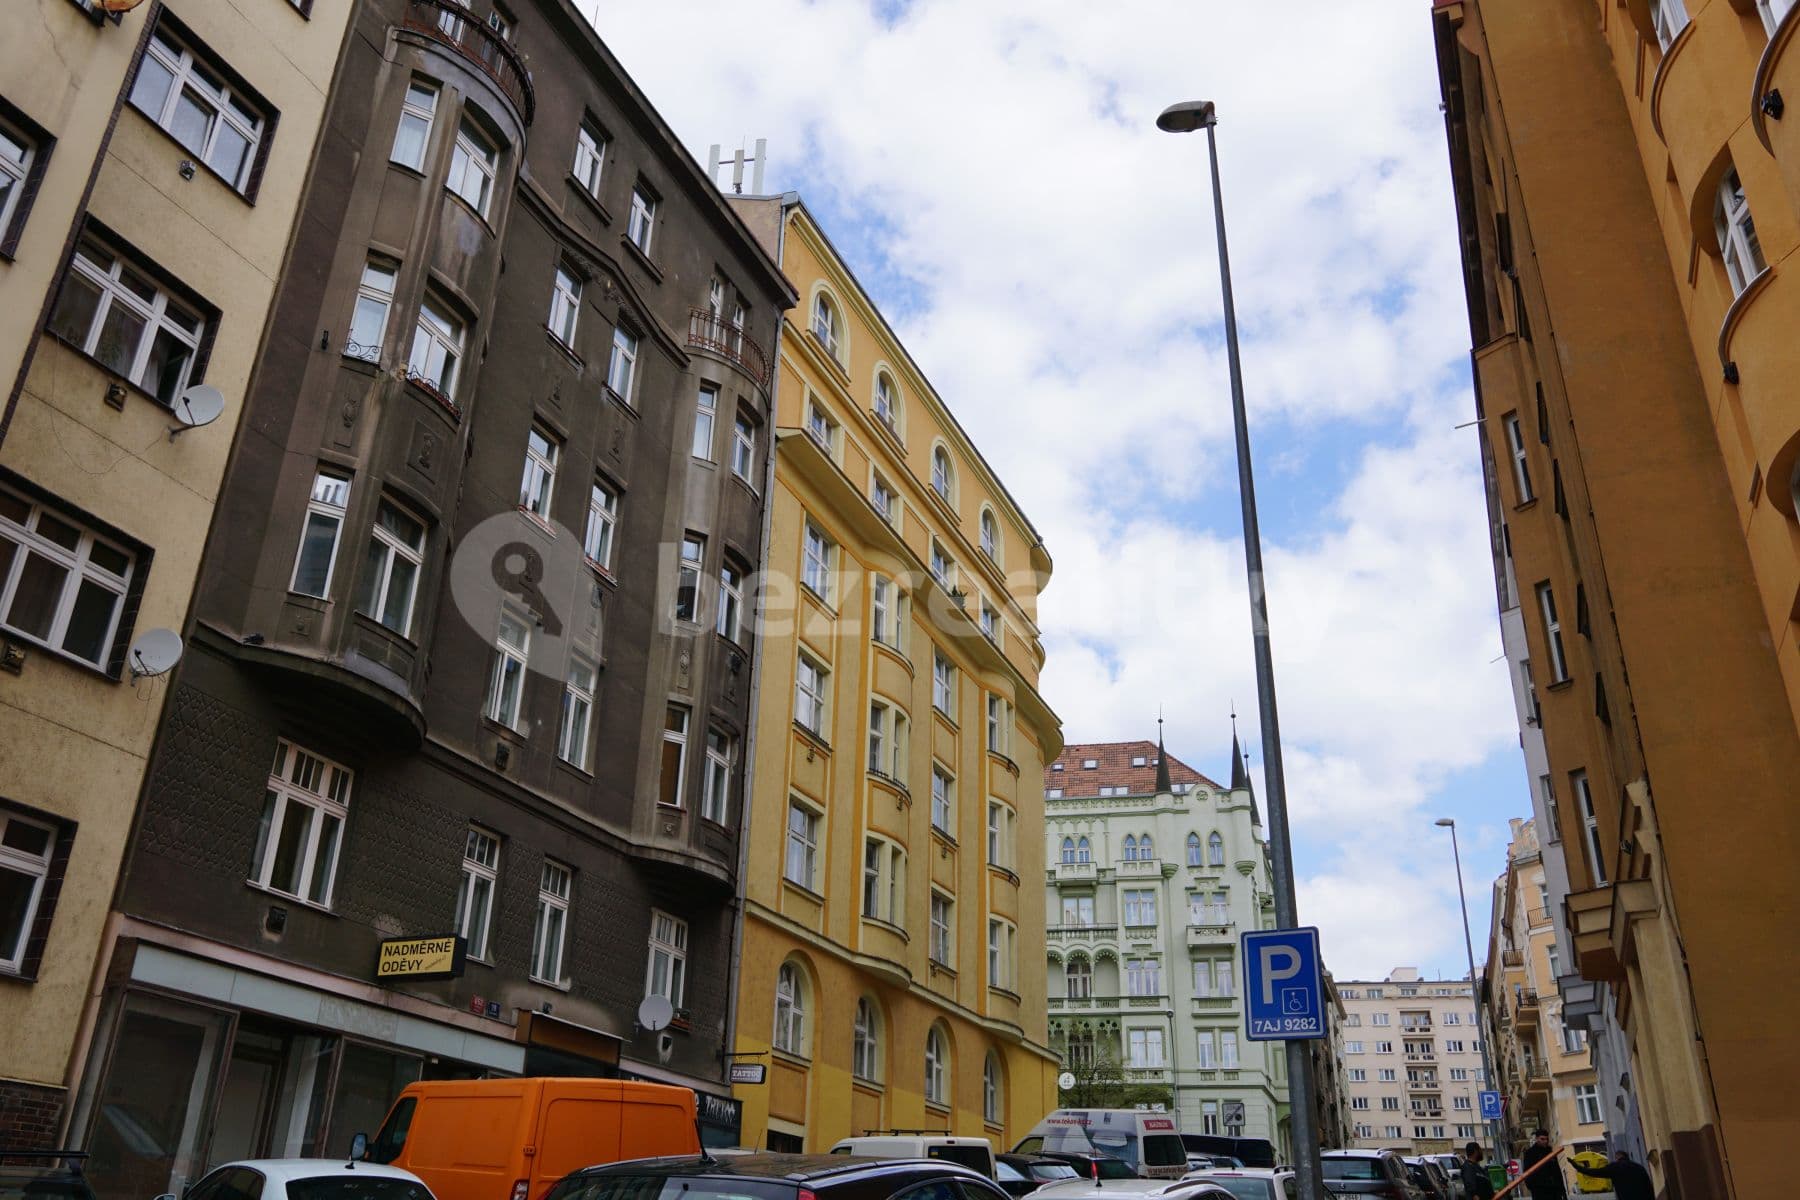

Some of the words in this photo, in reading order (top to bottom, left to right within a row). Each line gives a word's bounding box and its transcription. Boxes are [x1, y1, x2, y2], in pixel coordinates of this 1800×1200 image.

[382, 958, 424, 973] ODĚVY
[1259, 944, 1302, 1005] P
[1254, 1019, 1281, 1033] 7AJ
[1284, 1017, 1317, 1031] 9282
[1483, 1094, 1496, 1111] P
